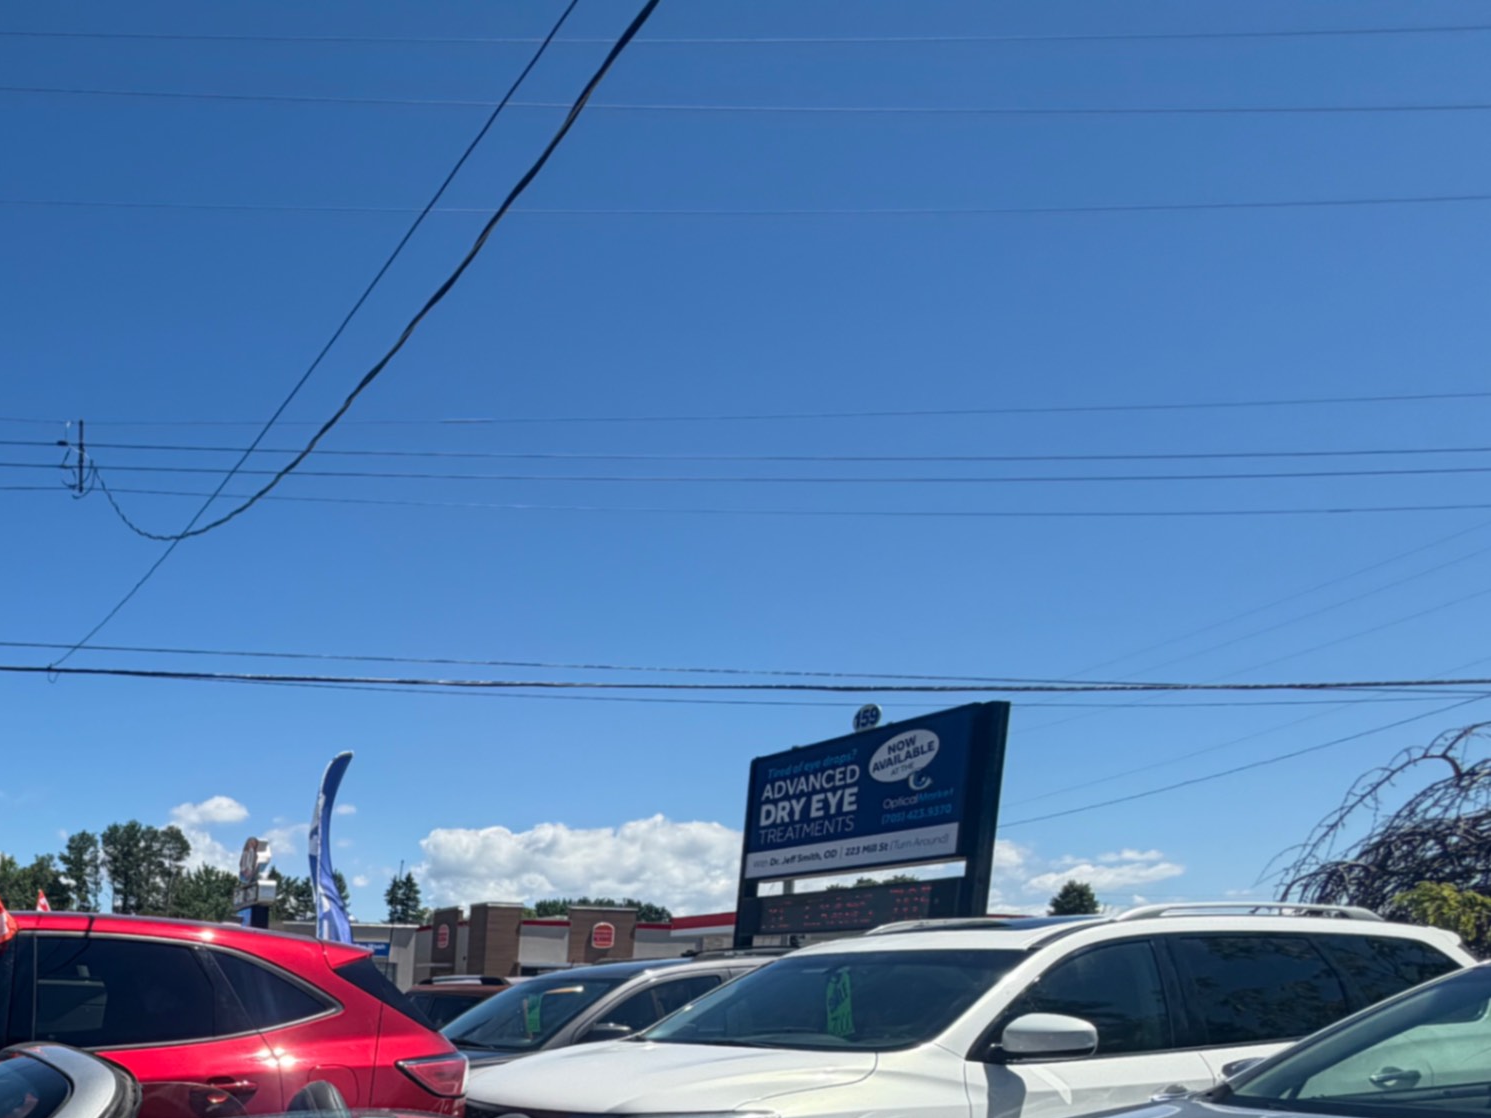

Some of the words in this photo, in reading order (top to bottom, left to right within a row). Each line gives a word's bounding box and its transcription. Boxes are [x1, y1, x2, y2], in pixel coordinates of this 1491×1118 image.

[872, 740, 936, 773] AVAILABLE
[888, 734, 917, 755] NOW
[761, 764, 860, 802] ADVANCED
[890, 767, 899, 777] AT
[901, 761, 915, 772] THE
[759, 797, 807, 827] DRY
[809, 786, 859, 819] EYE
[759, 814, 855, 845] TREATMENTS
[770, 857, 781, 867] Dr.
[782, 855, 796, 866] Jeff
[797, 851, 822, 863] Smith,
[823, 848, 838, 860] OD
[878, 841, 889, 852] St
